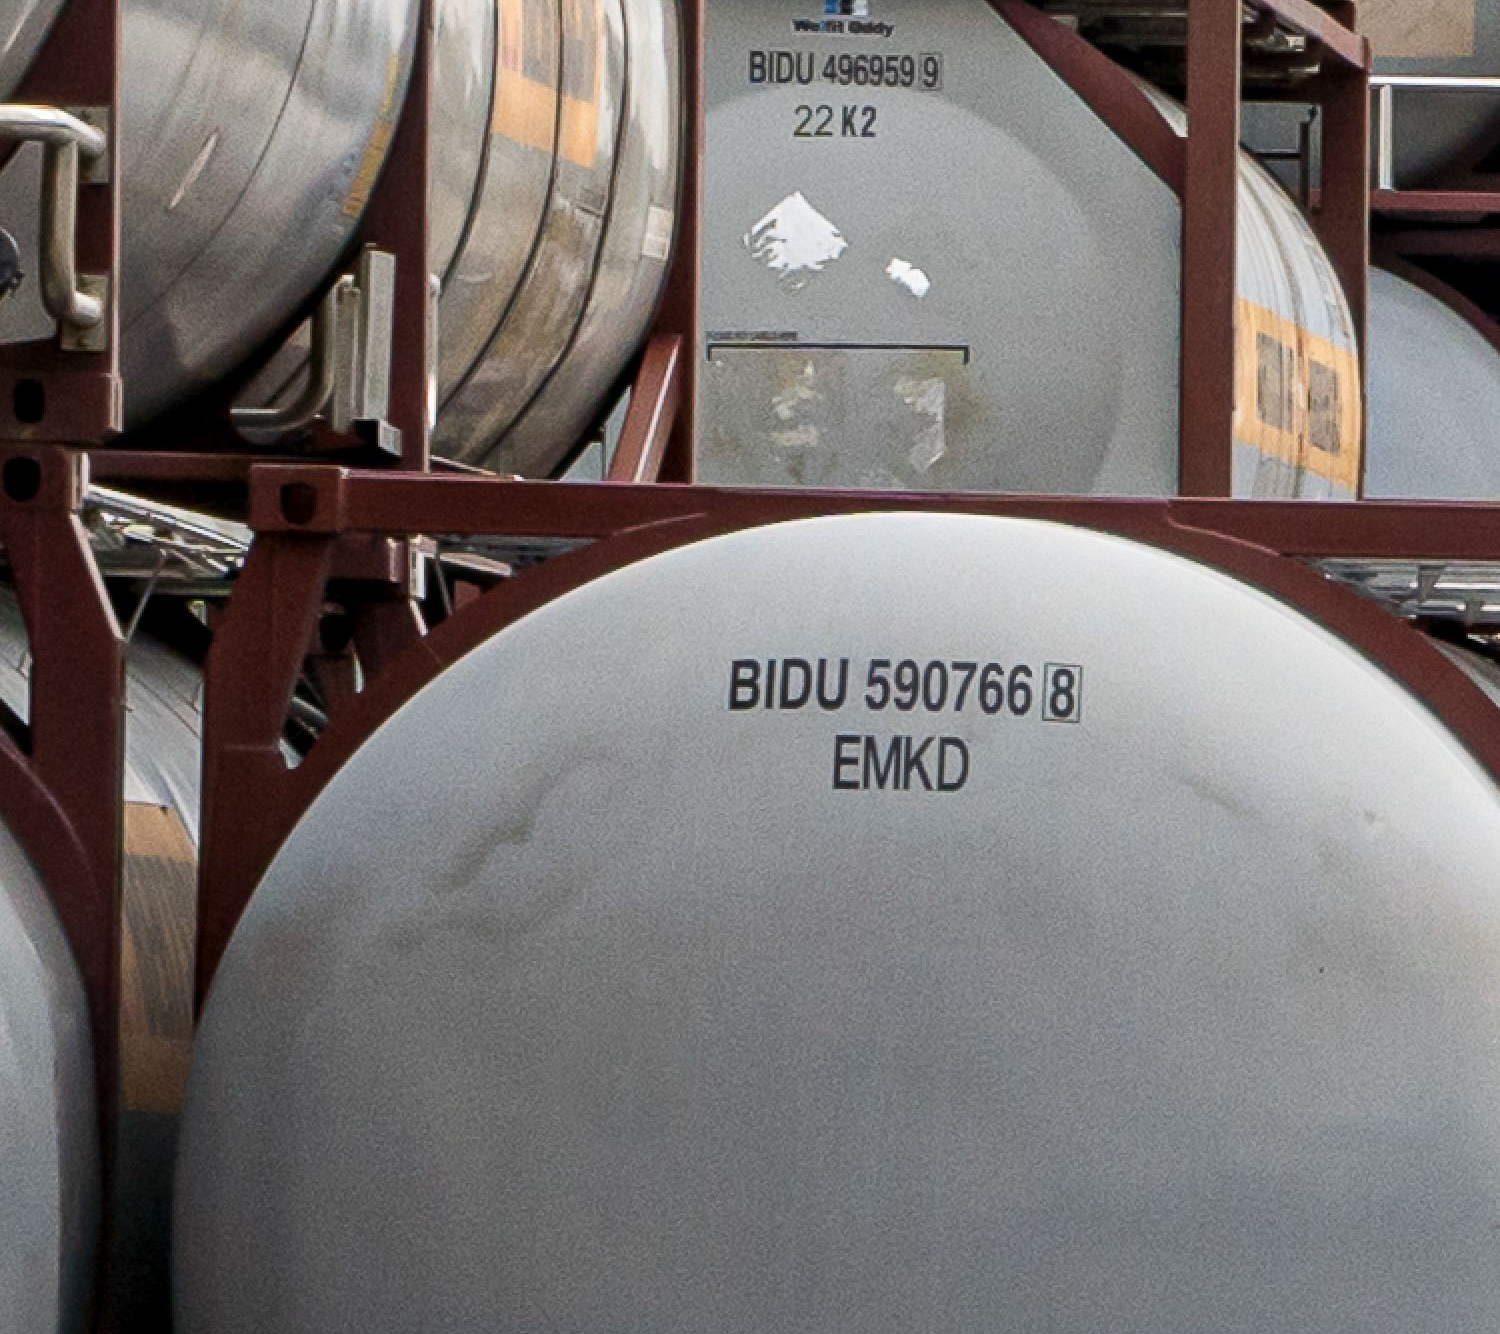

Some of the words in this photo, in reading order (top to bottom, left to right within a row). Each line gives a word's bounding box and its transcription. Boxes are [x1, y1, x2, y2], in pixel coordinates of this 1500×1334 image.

[749, 51, 815, 84] BIDU
[822, 54, 916, 87] 496959
[921, 54, 940, 88] 9
[727, 657, 850, 711] BIDU
[864, 658, 1033, 715] 590766
[1047, 667, 1077, 719] 8
[833, 734, 970, 791] EMKD
